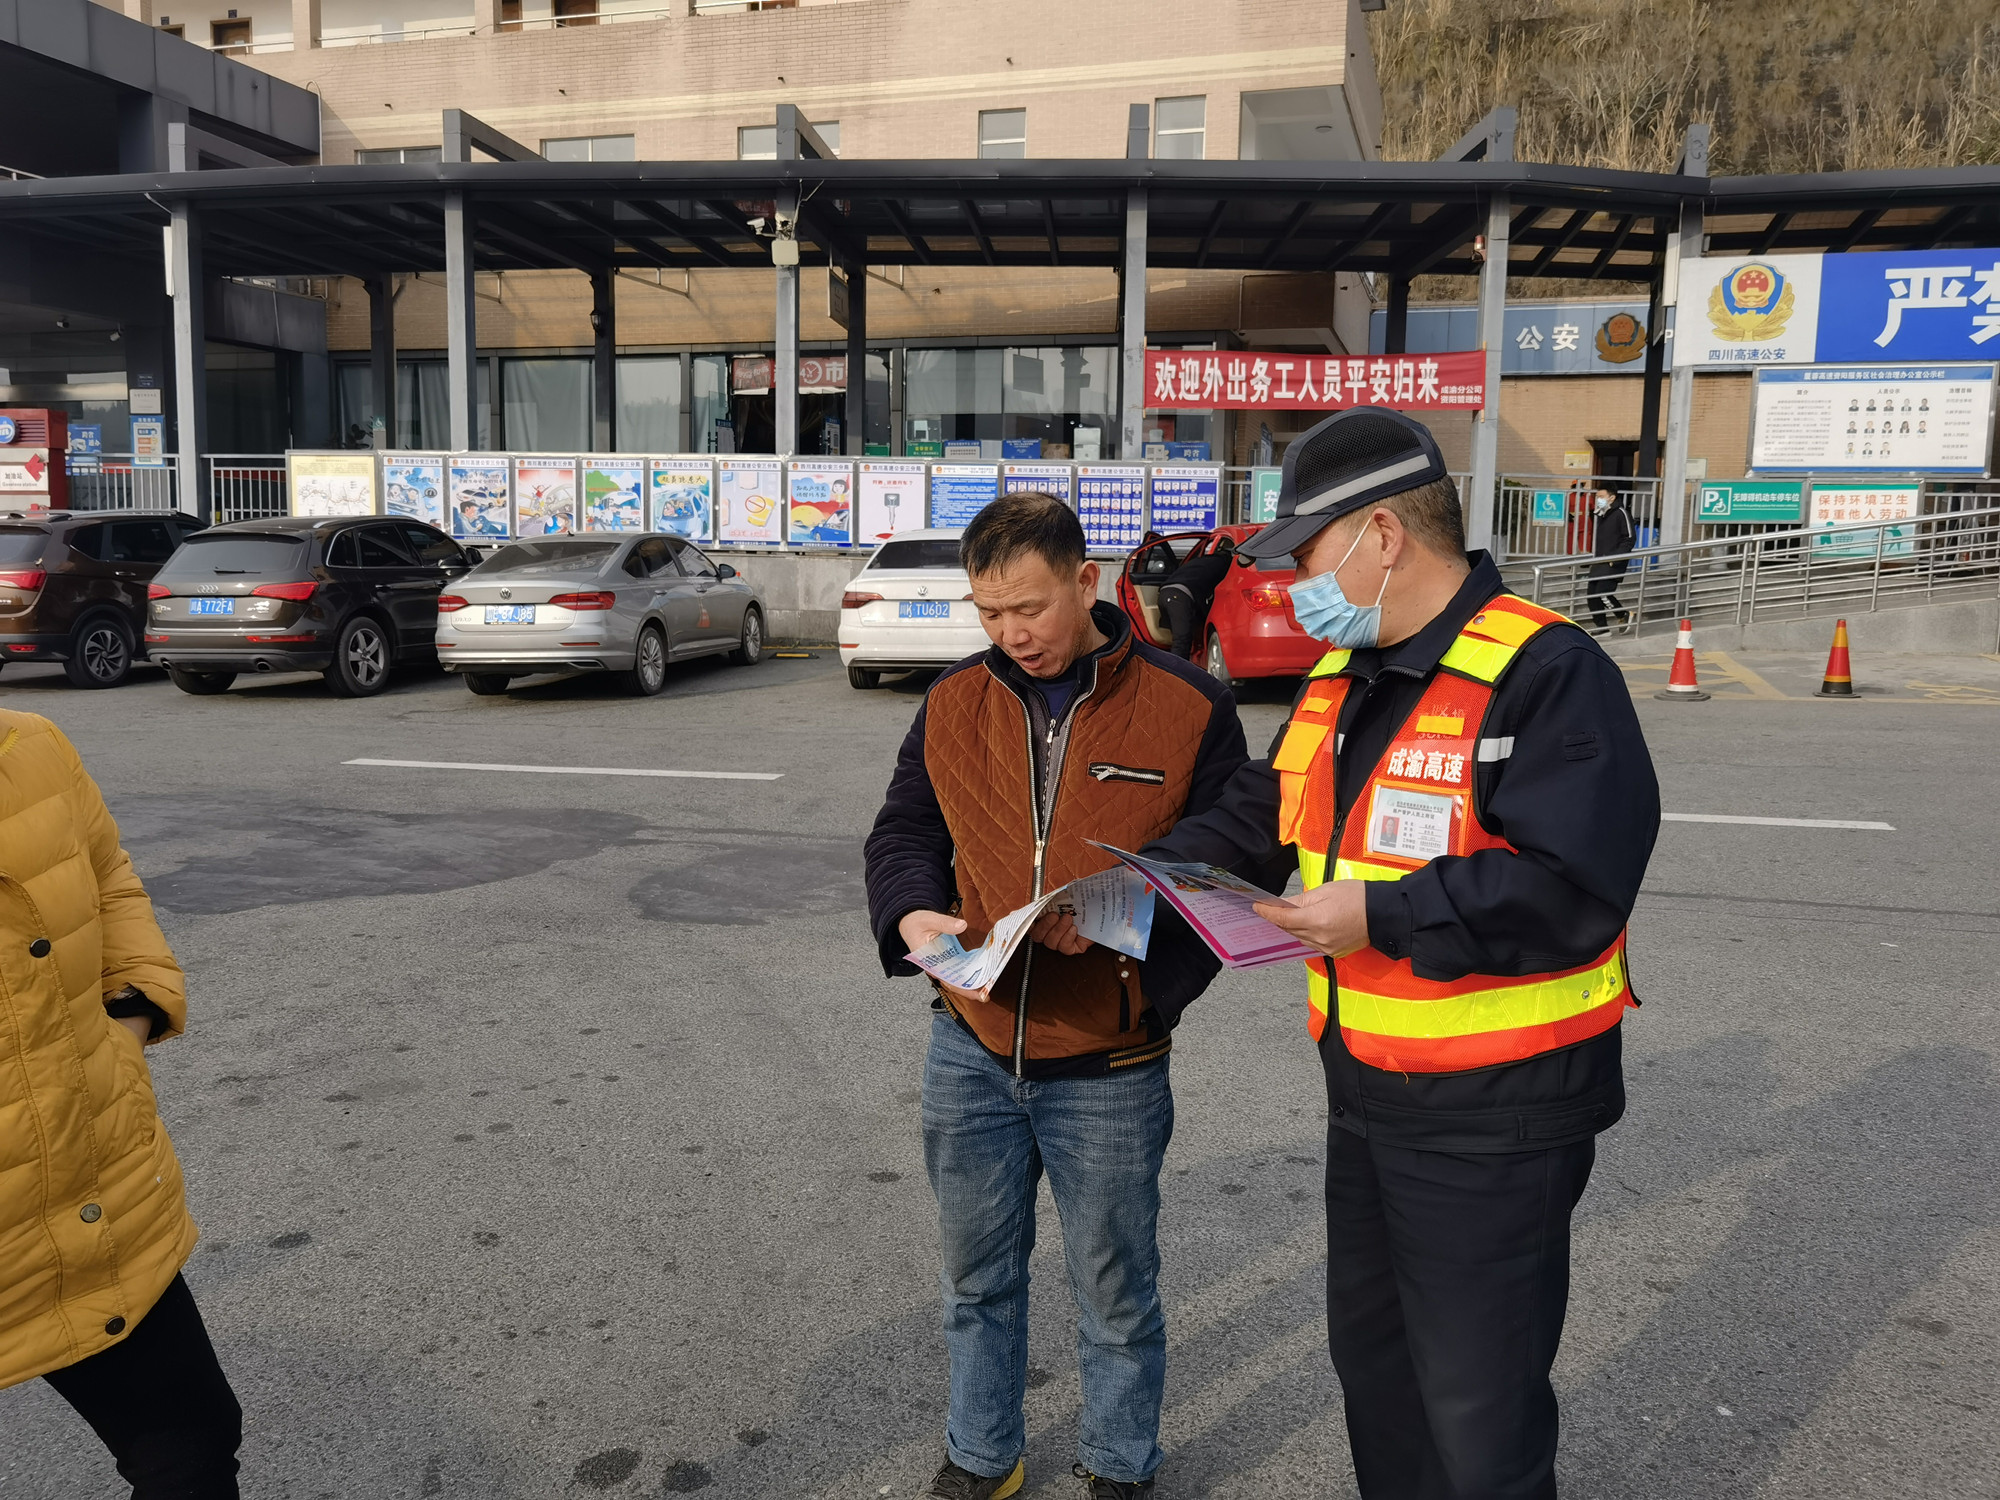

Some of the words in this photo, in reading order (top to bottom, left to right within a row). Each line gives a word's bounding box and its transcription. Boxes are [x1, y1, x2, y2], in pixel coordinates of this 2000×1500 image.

[1515, 323, 1580, 351] 公安
[1708, 347, 1786, 361] 四川高速公安
[1153, 356, 1440, 404] 欢迎外出务工人员平安归来
[1440, 384, 1482, 395] 成渝分公司
[1440, 395, 1482, 405] 资阳管理处
[1263, 489, 1278, 513] 安
[1732, 492, 1800, 502] 无障碍机动车停车位
[1818, 494, 1908, 505] 保持环境卫生
[1817, 508, 1908, 520] 尊重他人劳动
[1387, 747, 1465, 783] 成渝高速
